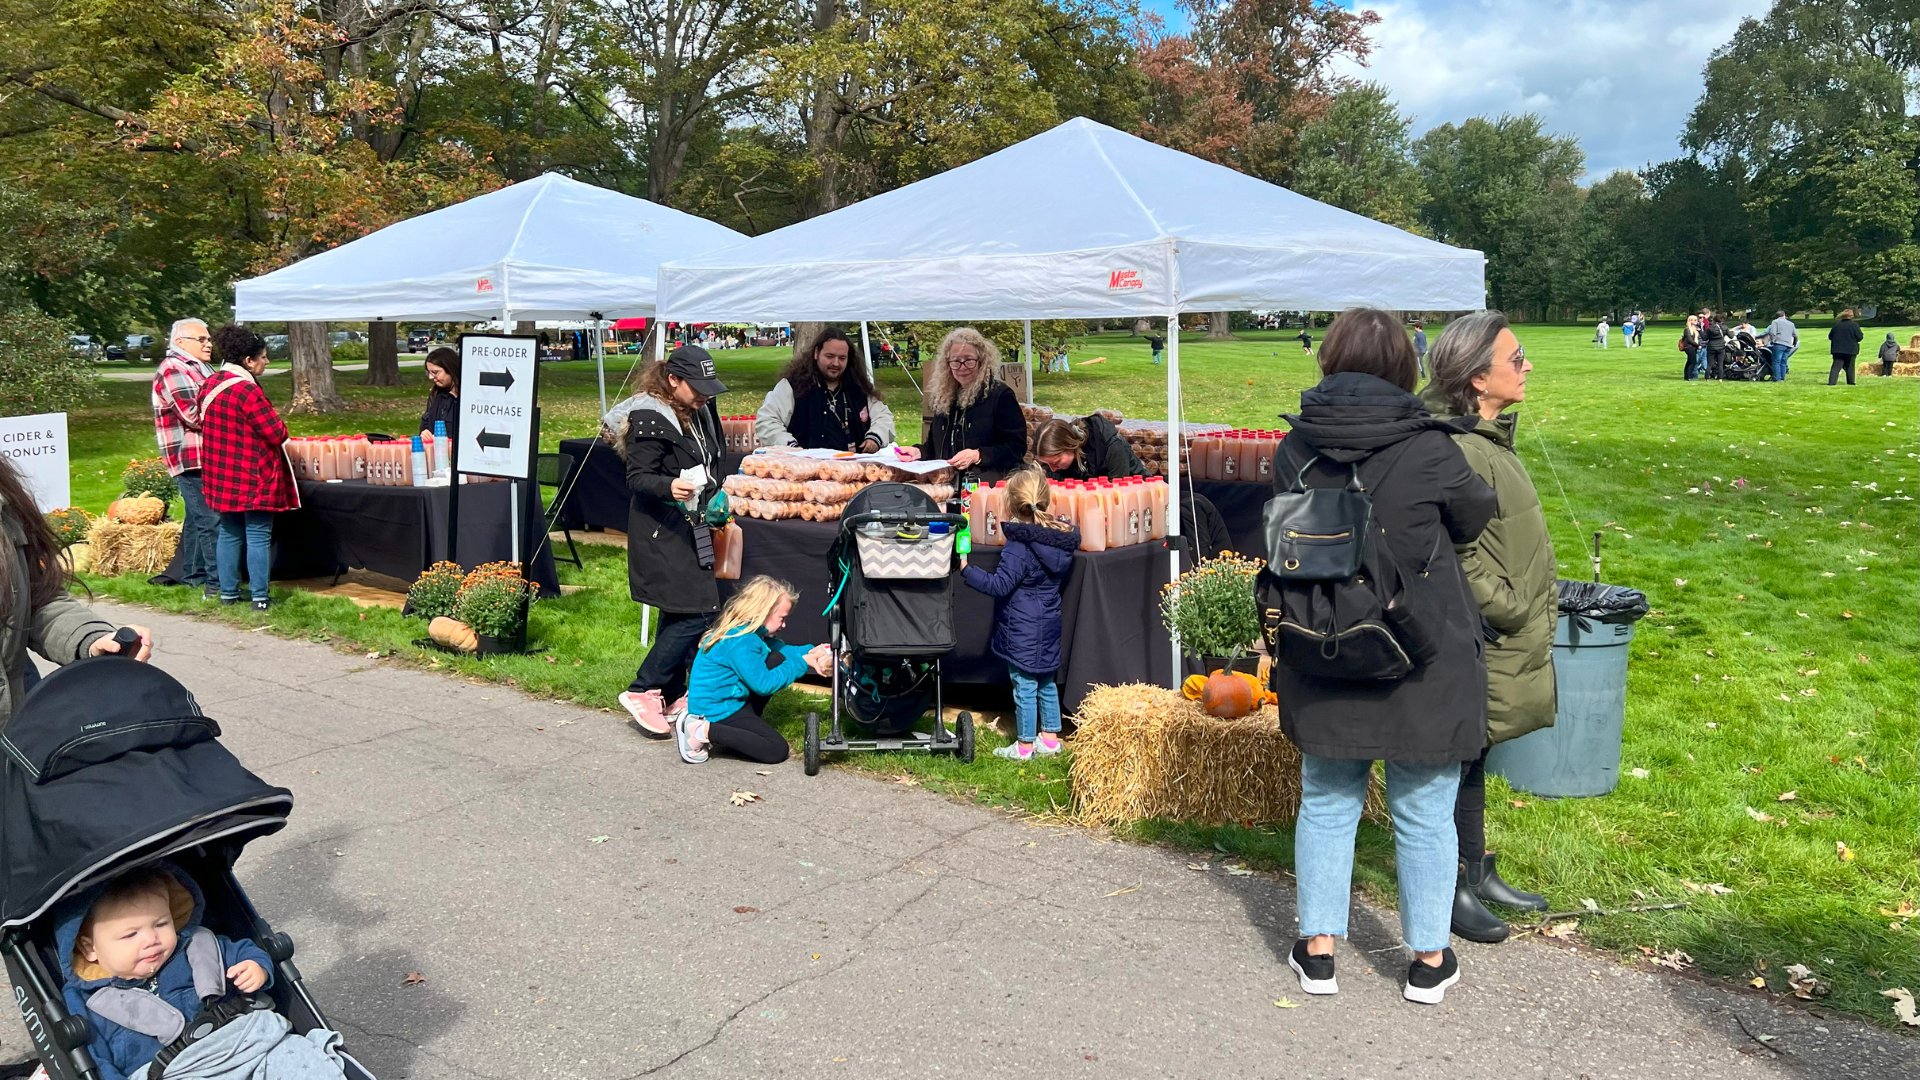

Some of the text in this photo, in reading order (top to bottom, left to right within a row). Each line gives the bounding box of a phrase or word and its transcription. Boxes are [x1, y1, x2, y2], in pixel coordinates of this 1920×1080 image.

[1109, 270, 1138, 288] Master
[1120, 279, 1144, 289] Canopy
[471, 346, 528, 358] PRE-ORDER
[470, 404, 522, 417] PURCHASE
[3, 429, 54, 443] CIDER &
[2, 445, 56, 458] DONUTS
